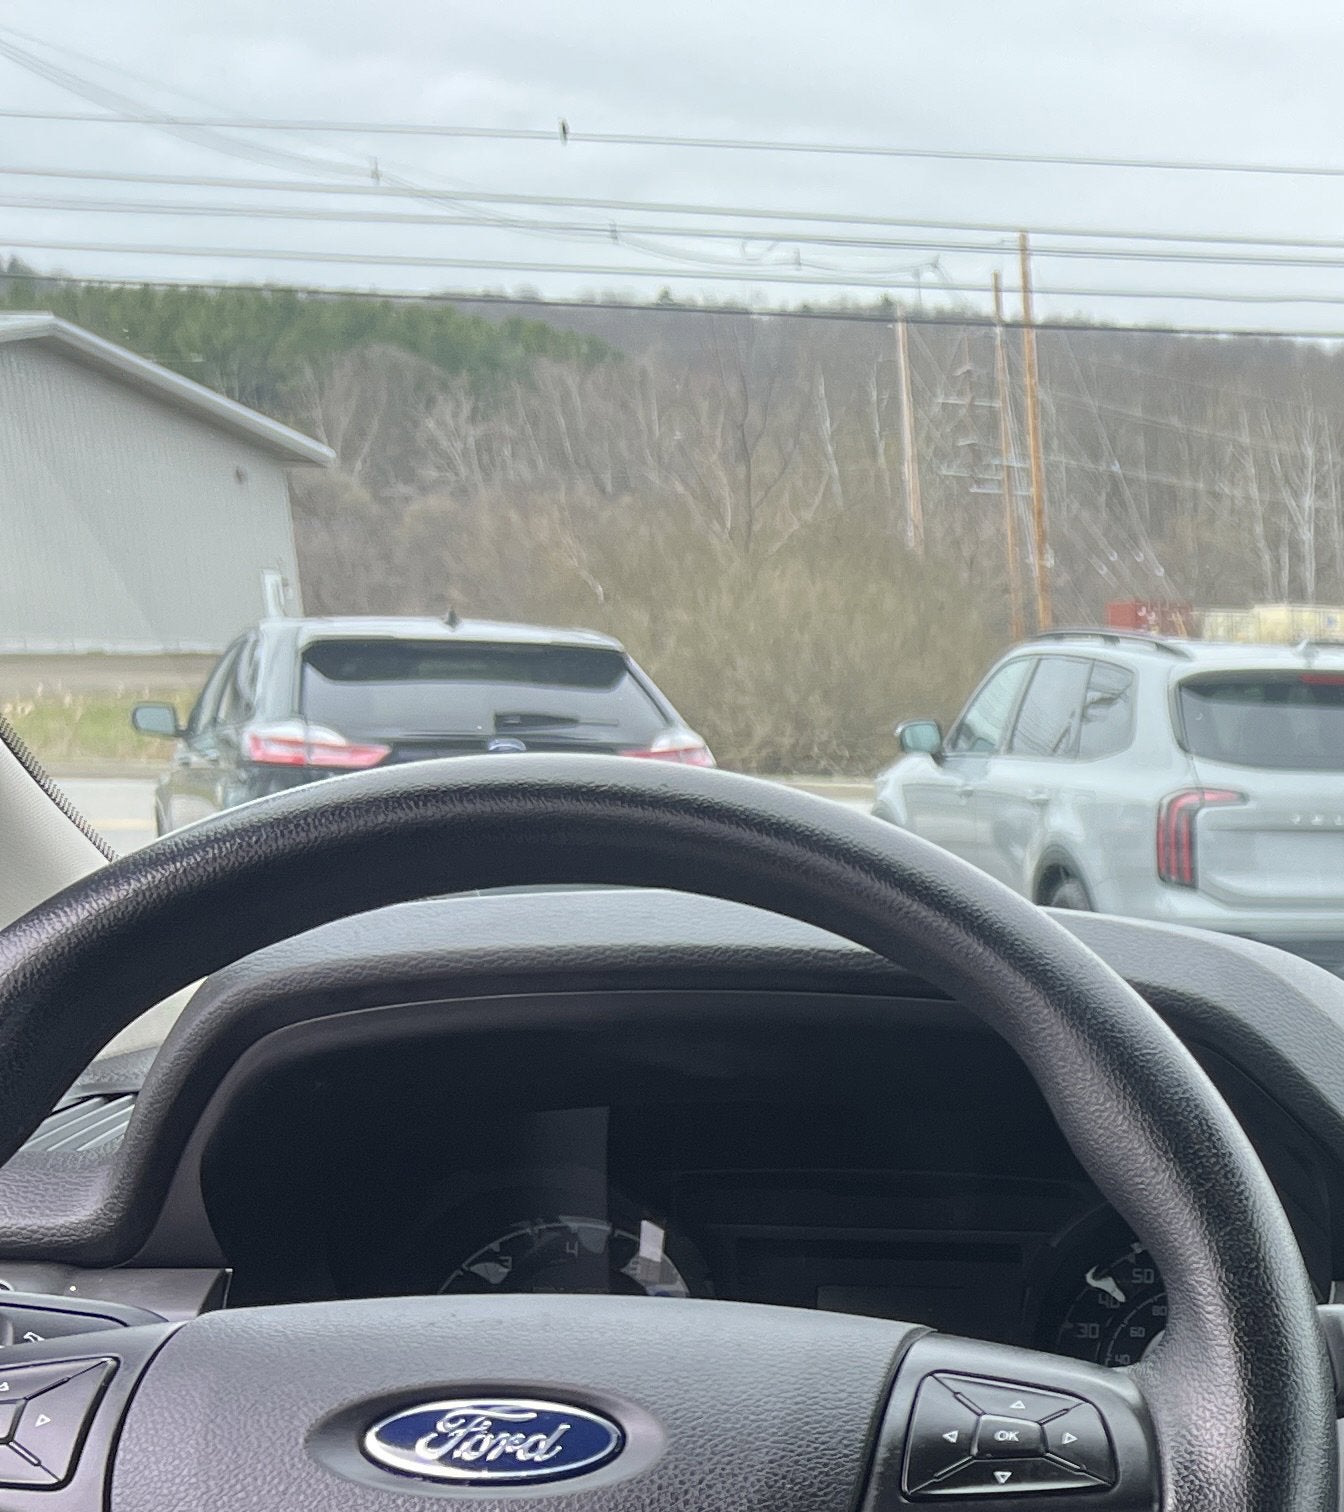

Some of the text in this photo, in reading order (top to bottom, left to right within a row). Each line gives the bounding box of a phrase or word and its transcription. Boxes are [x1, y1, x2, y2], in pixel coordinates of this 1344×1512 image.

[1132, 1268, 1155, 1284] 50
[1077, 1322, 1100, 1339] 30
[413, 1402, 573, 1463] Ford
[994, 1430, 1020, 1442] OK
